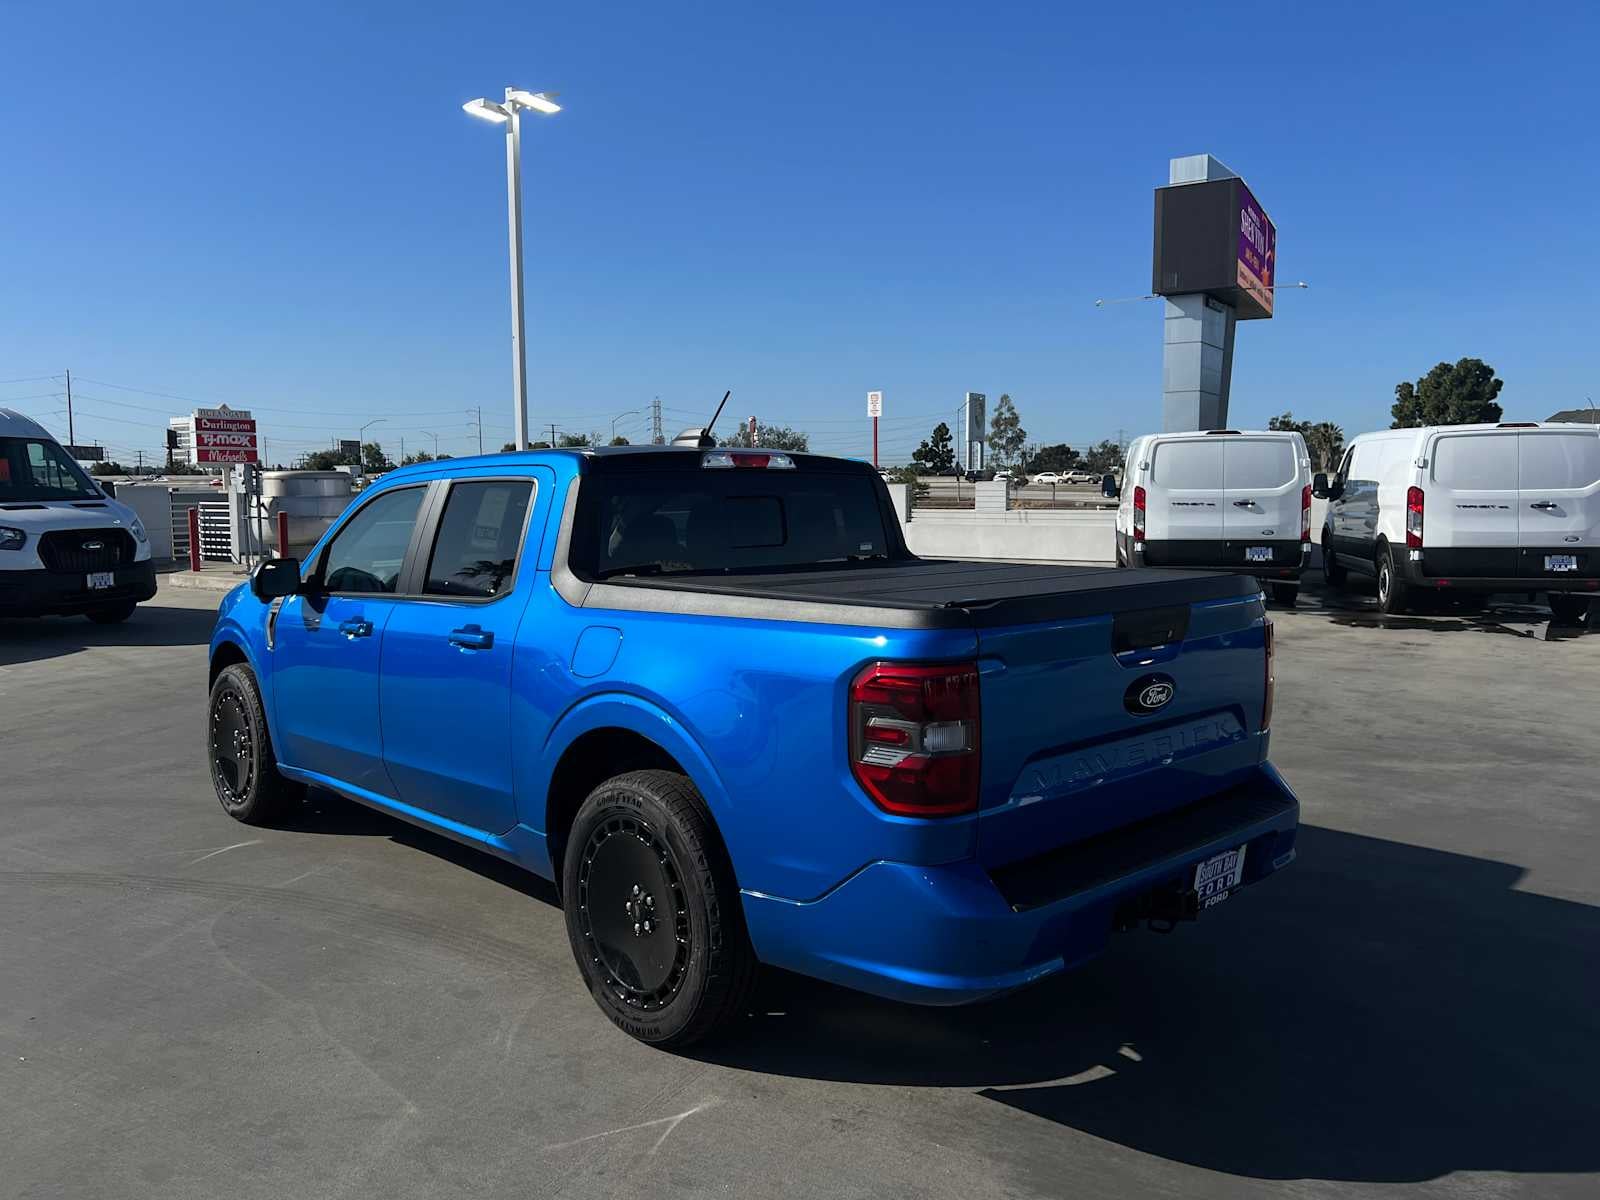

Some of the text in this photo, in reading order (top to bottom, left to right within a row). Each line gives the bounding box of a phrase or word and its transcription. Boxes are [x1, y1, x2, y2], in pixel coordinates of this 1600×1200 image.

[1146, 687, 1168, 705] Ford
[1200, 854, 1238, 882] SOUTH BAY
[1198, 874, 1234, 895] FORD
[1204, 890, 1229, 909] FORD
